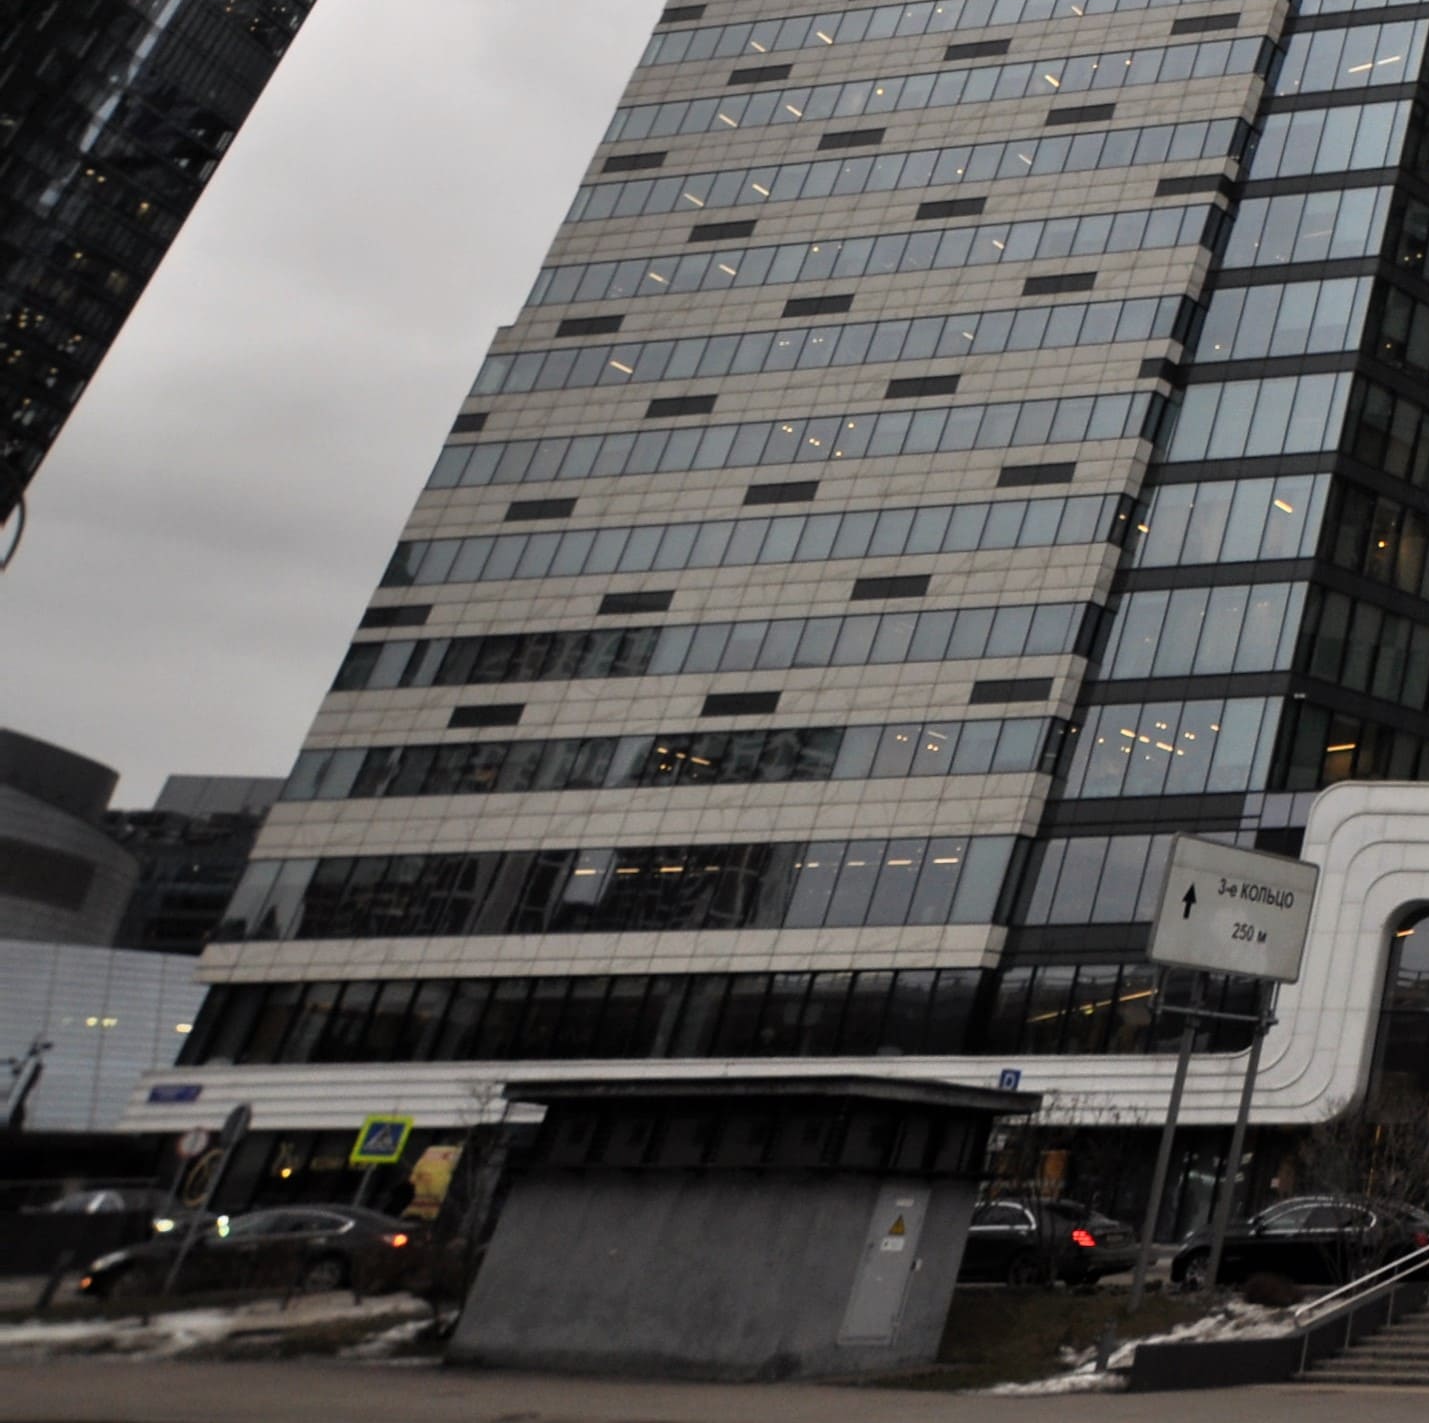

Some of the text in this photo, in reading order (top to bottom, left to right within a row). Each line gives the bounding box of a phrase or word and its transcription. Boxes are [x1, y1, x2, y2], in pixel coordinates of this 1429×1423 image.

[1218, 877, 1295, 911] 3-е КОЛЬЦО
[1231, 922, 1254, 942] 250
